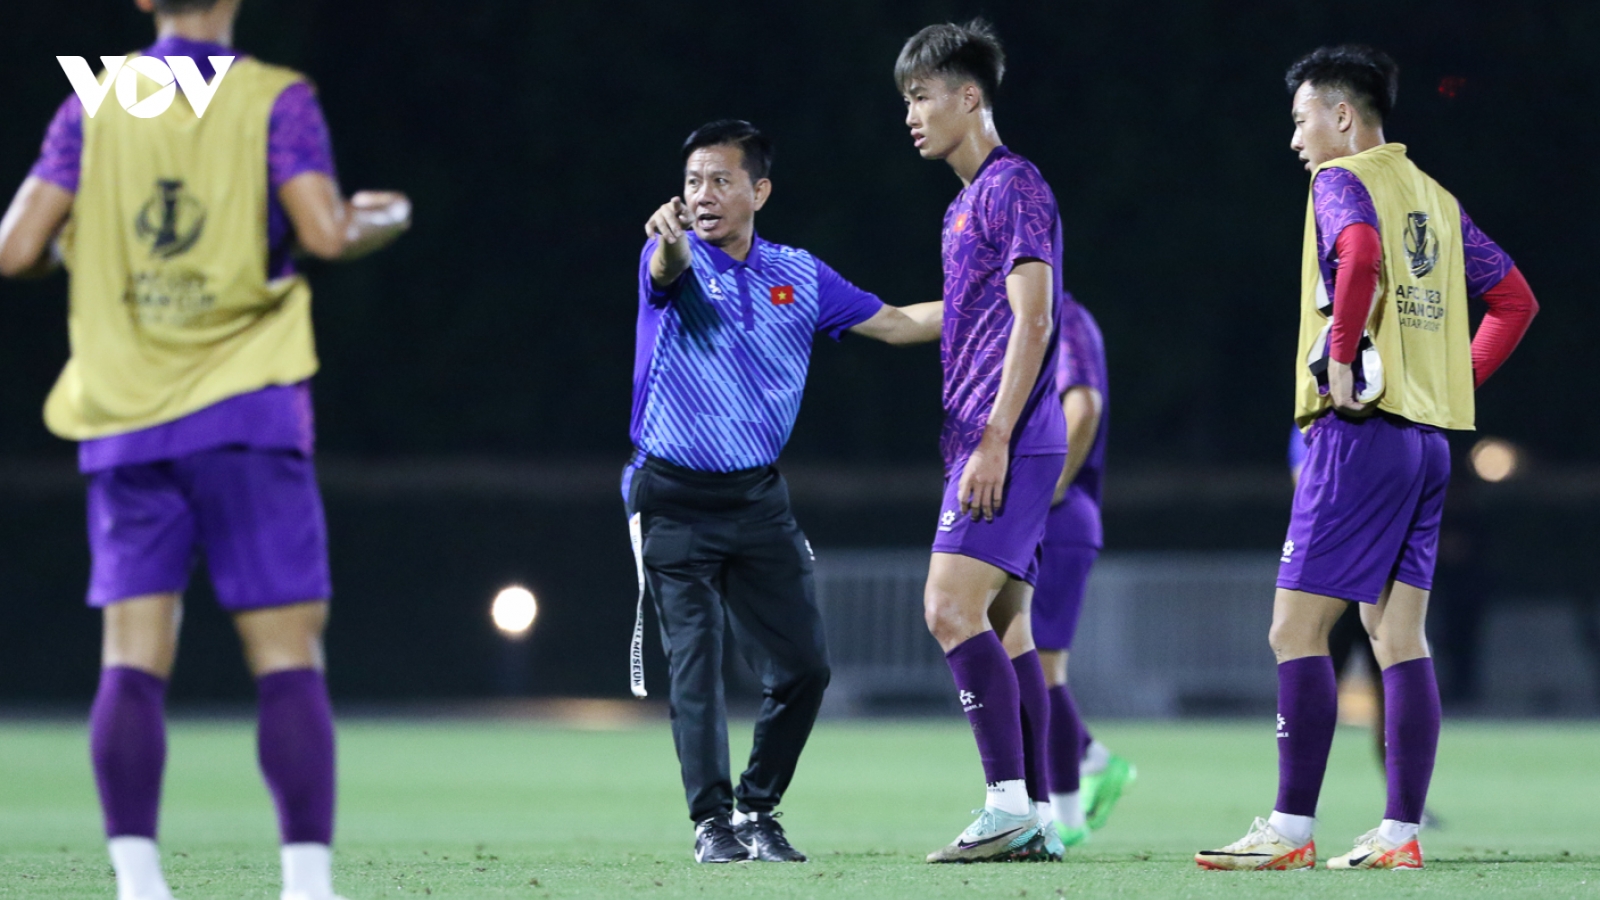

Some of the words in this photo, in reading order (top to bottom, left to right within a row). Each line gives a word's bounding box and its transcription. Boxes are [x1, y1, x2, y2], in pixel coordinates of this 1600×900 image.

[1396, 284, 1420, 300] AFC
[1397, 300, 1424, 317] SIAN
[1426, 305, 1444, 319] CUP
[1400, 317, 1422, 329] ATAR
[633, 641, 642, 687] MUSEUM
